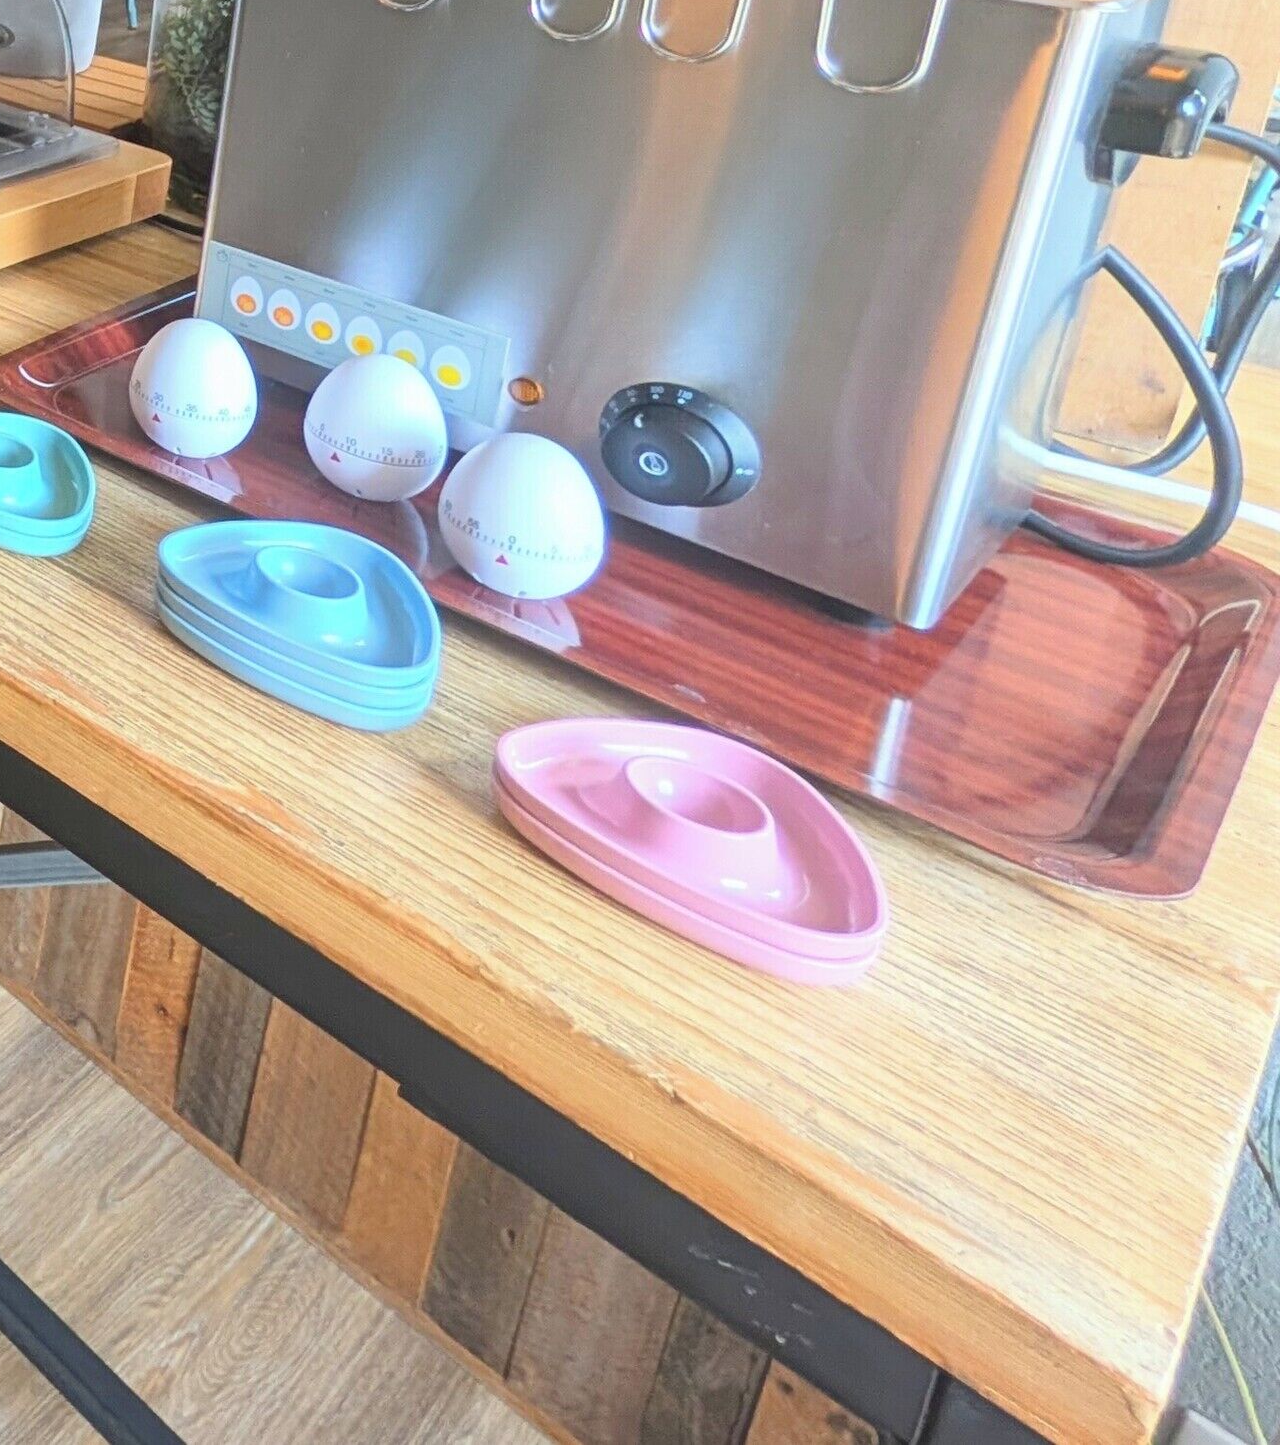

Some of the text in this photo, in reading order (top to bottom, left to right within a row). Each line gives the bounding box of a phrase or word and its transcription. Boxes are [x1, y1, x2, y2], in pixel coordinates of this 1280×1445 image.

[345, 436, 357, 447] 10
[381, 446, 395, 457] 15
[508, 535, 517, 545] 0
